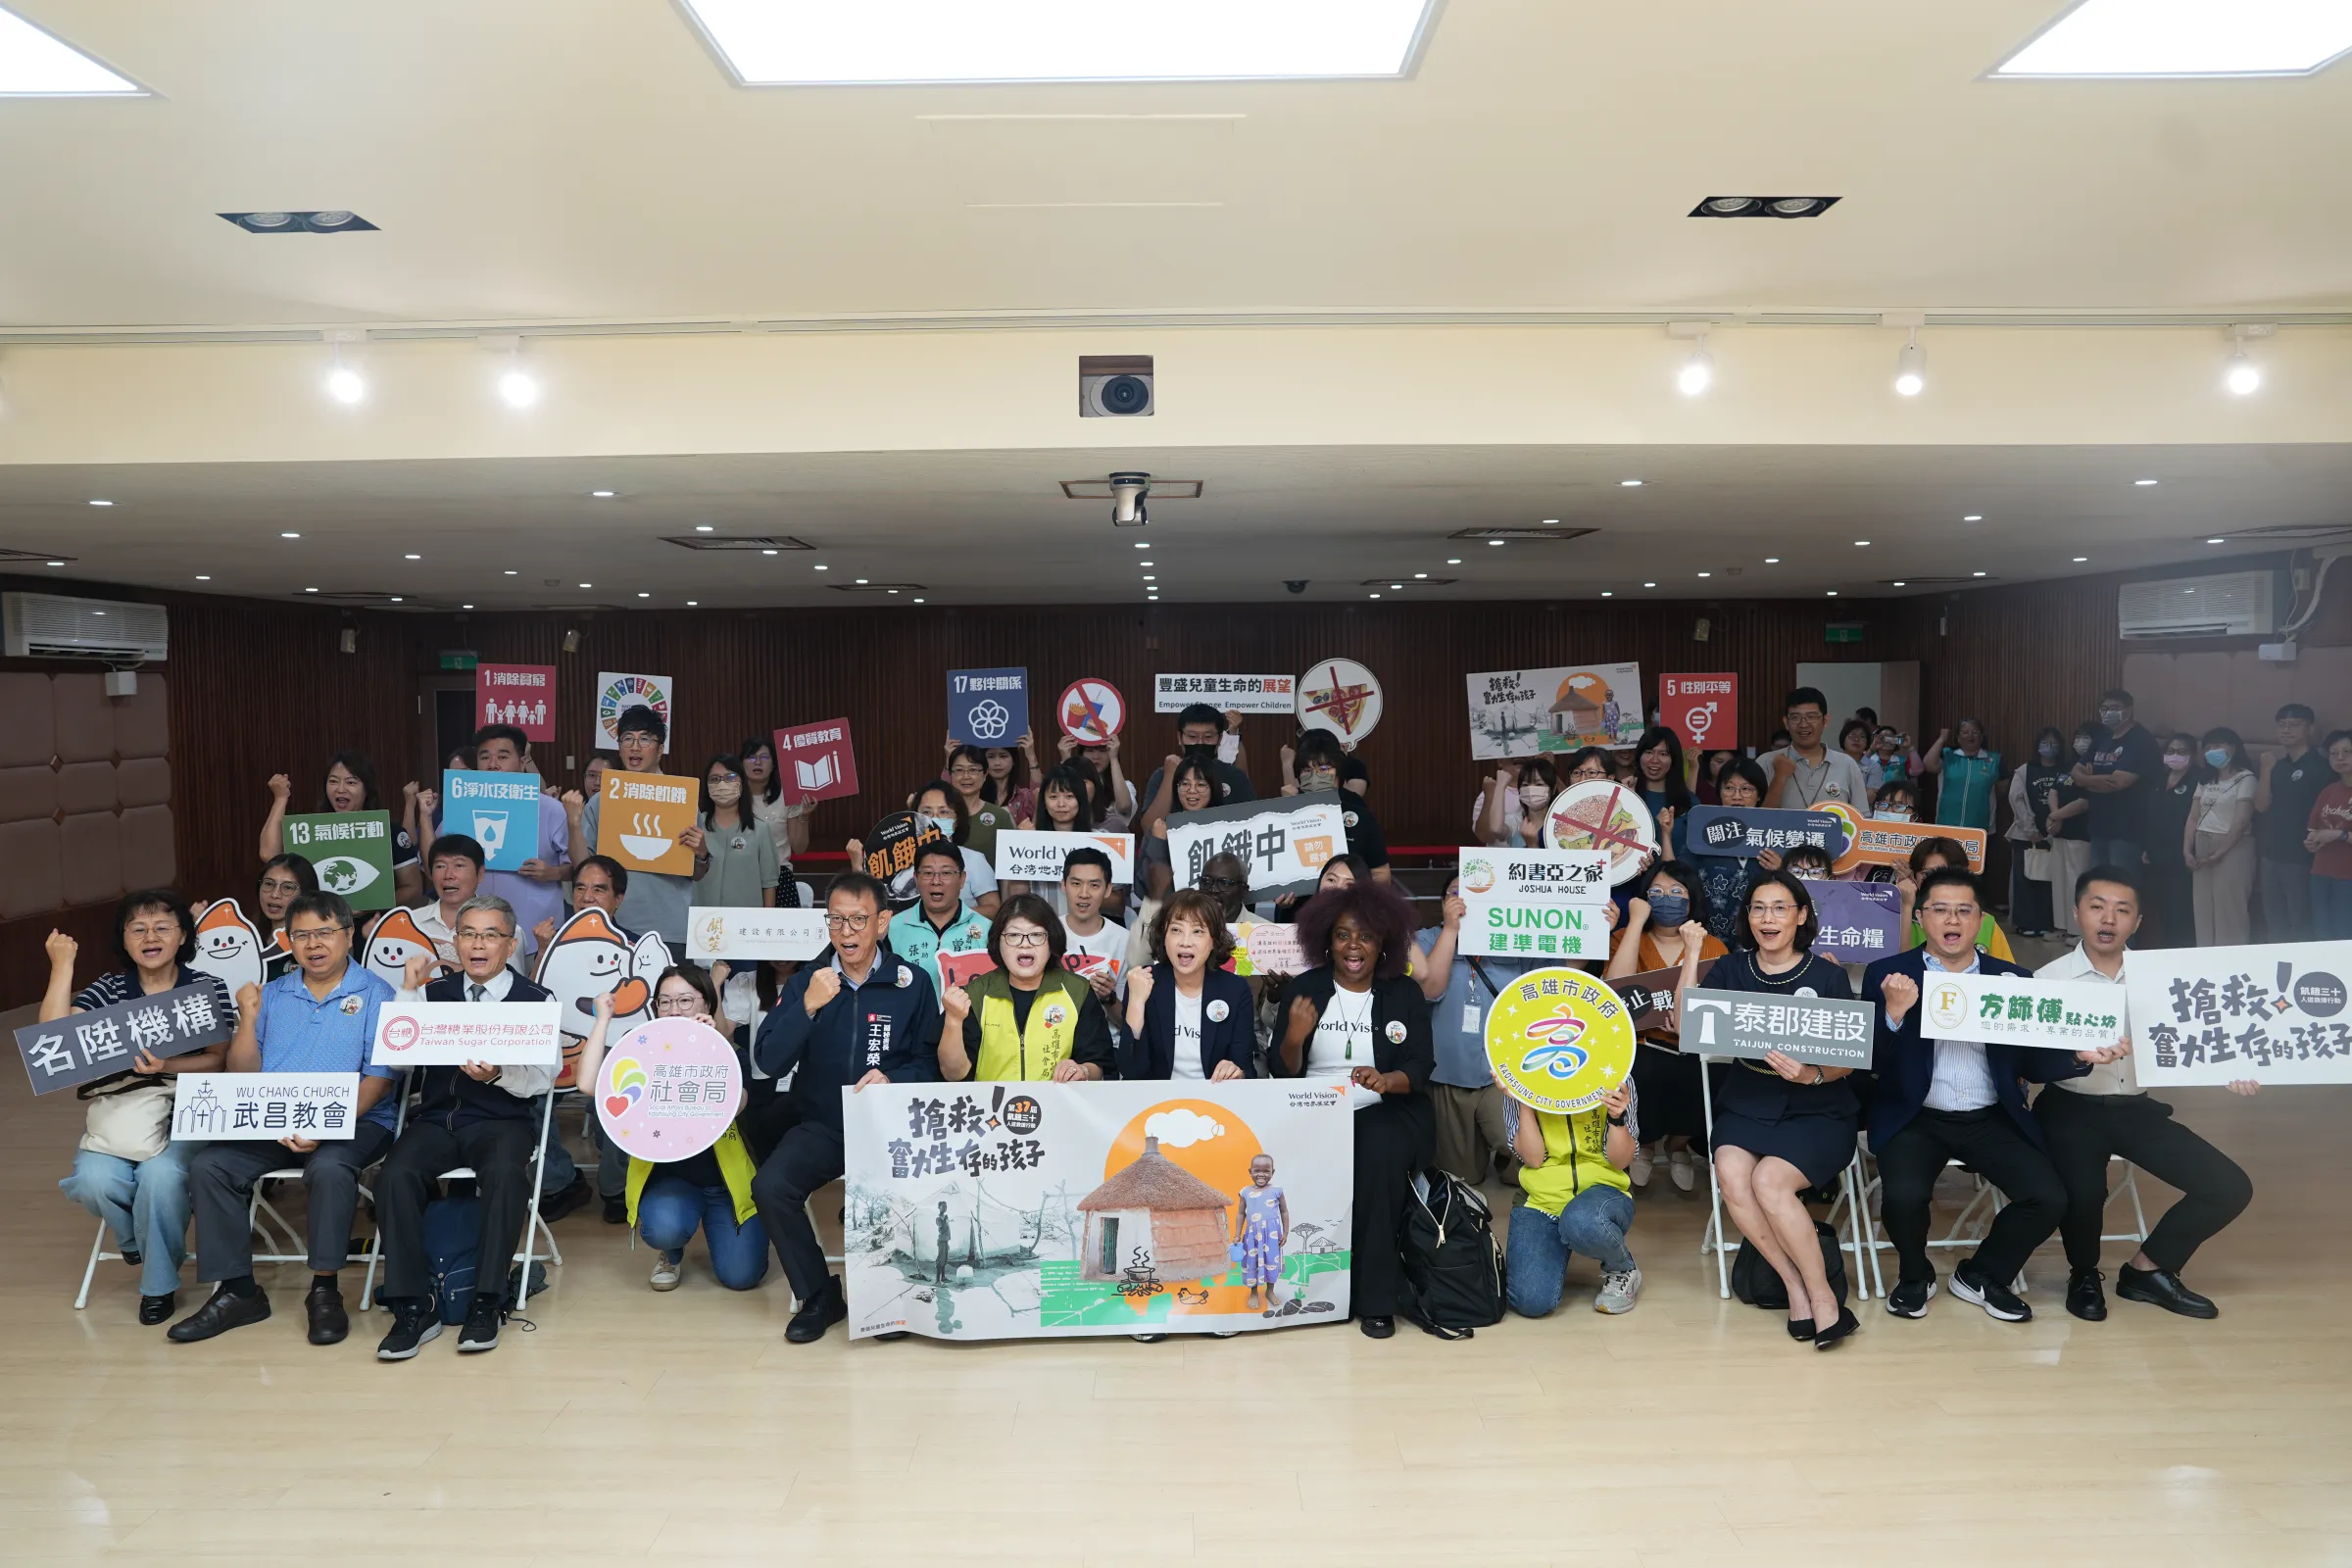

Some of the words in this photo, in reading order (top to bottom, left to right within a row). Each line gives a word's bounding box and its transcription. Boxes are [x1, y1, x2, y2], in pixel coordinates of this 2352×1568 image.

[485, 670, 490, 686] 1
[493, 672, 546, 687] 消除貧窮
[954, 676, 968, 693] 17
[970, 676, 1022, 691] 夥伴關係
[1158, 678, 1292, 693] 豐盛兒童生命的展望
[1667, 680, 1675, 696] 5
[1680, 680, 1731, 695] 性別平等
[782, 734, 792, 751] 4
[793, 728, 842, 749] 優質教育
[609, 777, 620, 801] 2
[622, 781, 687, 804] 消除飢餓
[290, 822, 311, 845] 13
[315, 820, 384, 841] 氣候行動
[1009, 845, 1056, 860] World
[1508, 862, 1604, 883] 約書亞之家
[1519, 884, 1552, 894] JOSHUA
[1558, 885, 1587, 895] HOUSE
[1488, 907, 1582, 931] SUNON
[738, 928, 810, 937] 建設有限公司
[1812, 925, 1884, 949] 生命糧
[1489, 932, 1582, 955] 建準電機
[1519, 978, 1619, 1020] 高雄市政府
[1940, 991, 1957, 1010] F
[2300, 986, 2341, 996] 飢餓三十
[420, 1024, 554, 1036] 台灣糖業股份有限公司
[1351, 1022, 1372, 1033] Visi
[1734, 1002, 1866, 1043] 泰郡建設
[27, 992, 218, 1077] 名陞機構
[388, 1027, 413, 1039] 台糖
[420, 1037, 455, 1046] Taiwan
[458, 1037, 488, 1048] Sugar
[490, 1037, 552, 1047] Corporation
[1184, 1027, 1201, 1039] Vis
[866, 1024, 882, 1066] 王宏榮
[1733, 1039, 1772, 1050] TAIJUN
[1777, 1042, 1865, 1058] CONSTRUCTION
[2148, 1022, 2352, 1068] 奮力生存的孩子
[653, 1064, 729, 1078] 高雄市政府
[236, 1087, 255, 1098] WU
[258, 1086, 299, 1098] CHANG
[303, 1086, 350, 1098] CHURCH
[650, 1080, 726, 1103] 社會局
[1498, 1063, 1533, 1100] KAOHSIUNG
[1535, 1095, 1553, 1107] CITY
[1555, 1086, 1607, 1108] GOVERNMENT
[234, 1102, 348, 1129] 武昌教會
[888, 1138, 1045, 1179] 奮力生存的孩子
